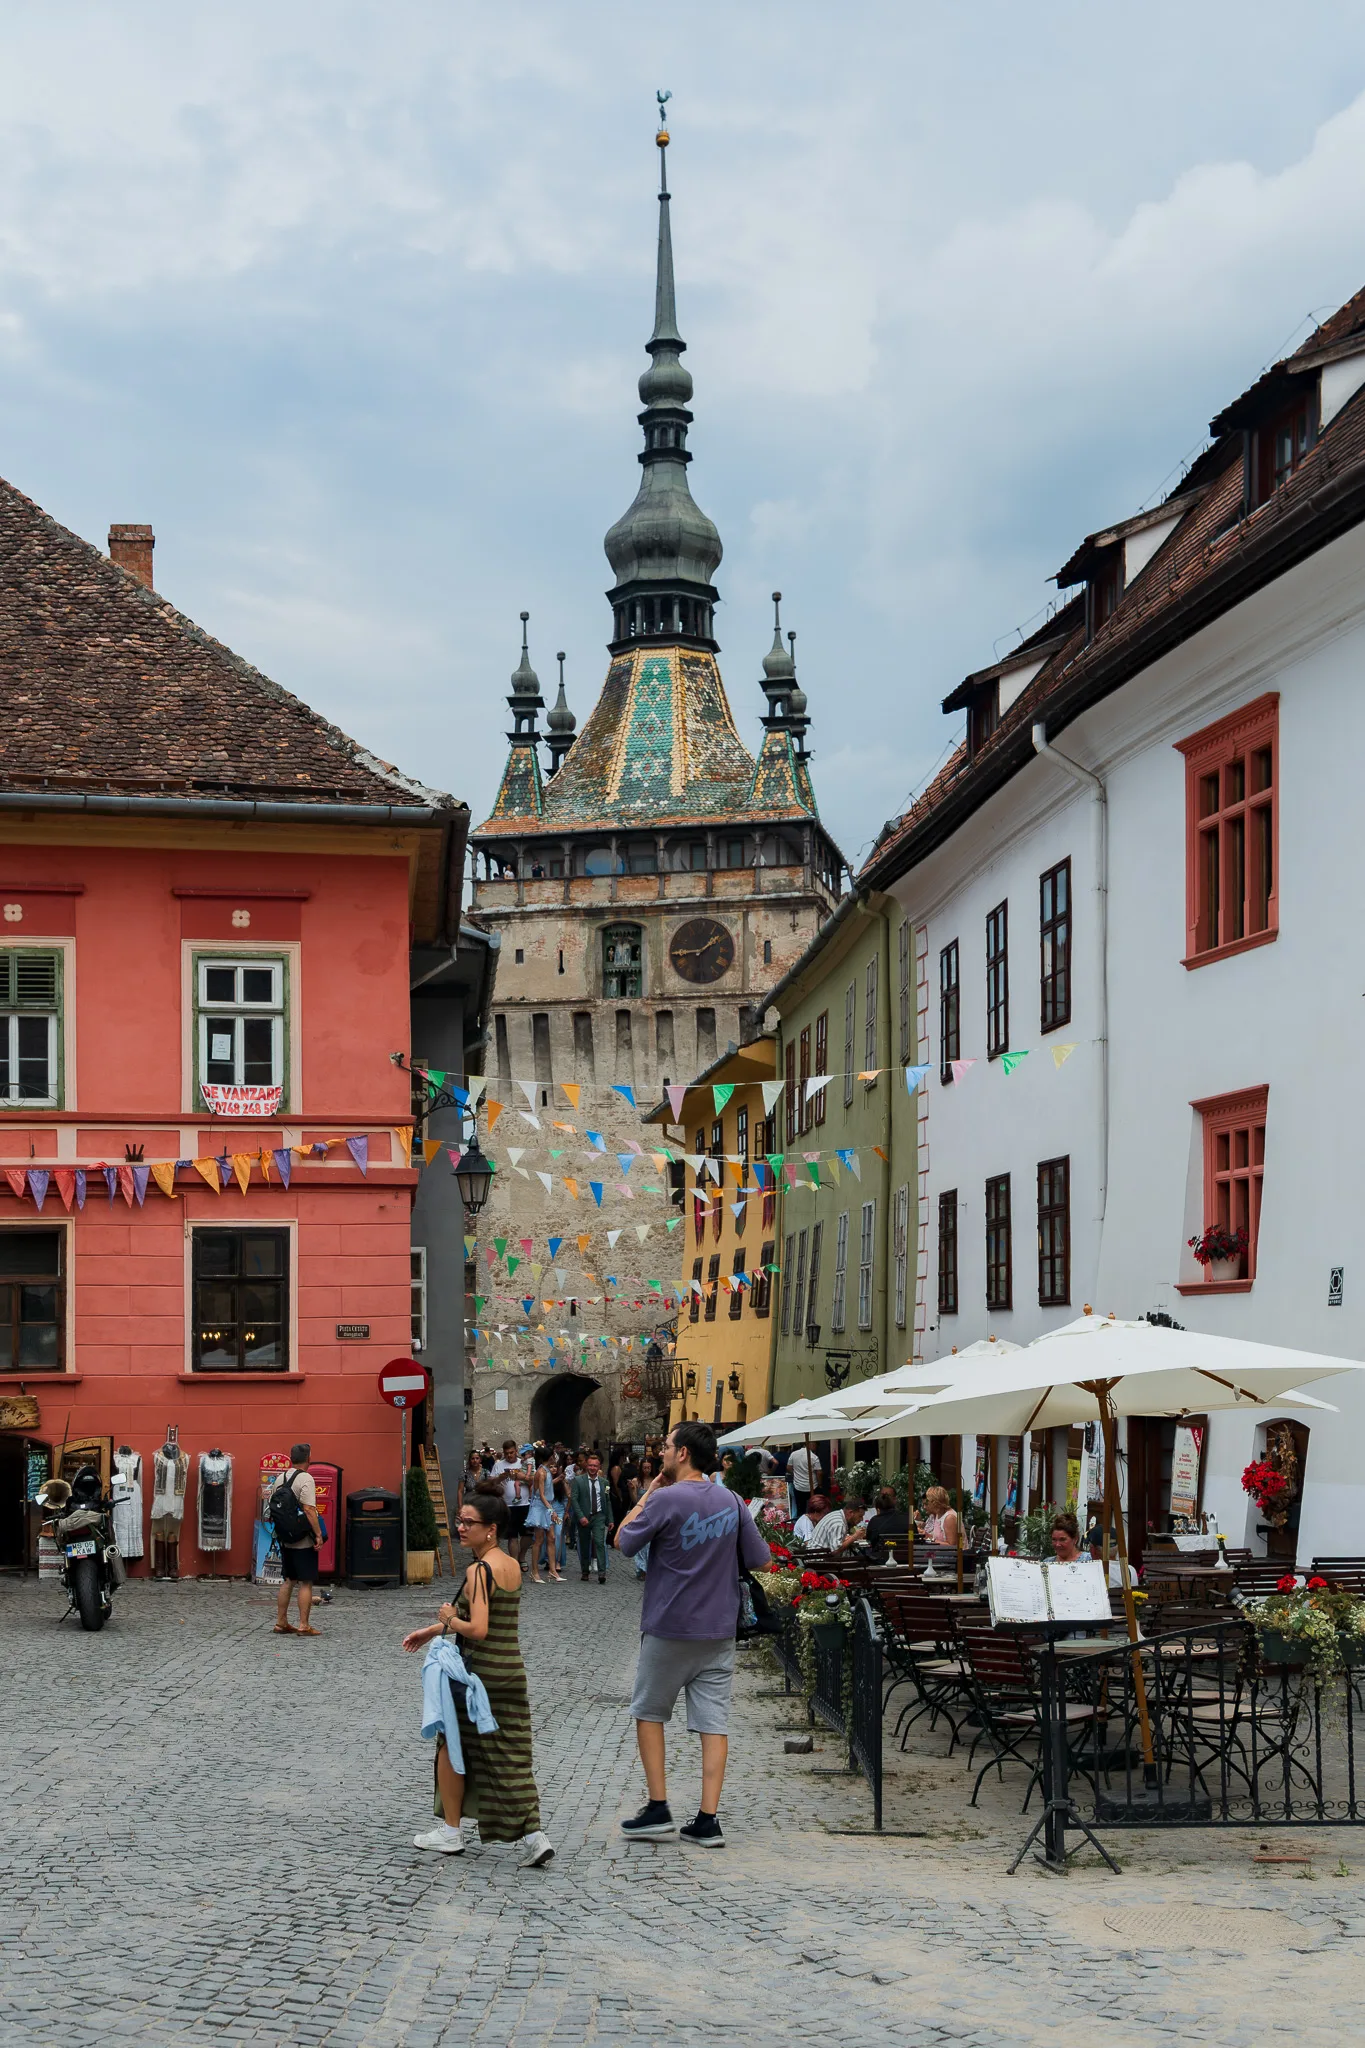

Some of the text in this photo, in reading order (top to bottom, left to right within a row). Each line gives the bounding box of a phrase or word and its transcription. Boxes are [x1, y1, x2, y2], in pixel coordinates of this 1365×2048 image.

[202, 1085, 282, 1101] DE VANZARE
[215, 1101, 240, 1114] 0748
[242, 1102, 261, 1114] 248
